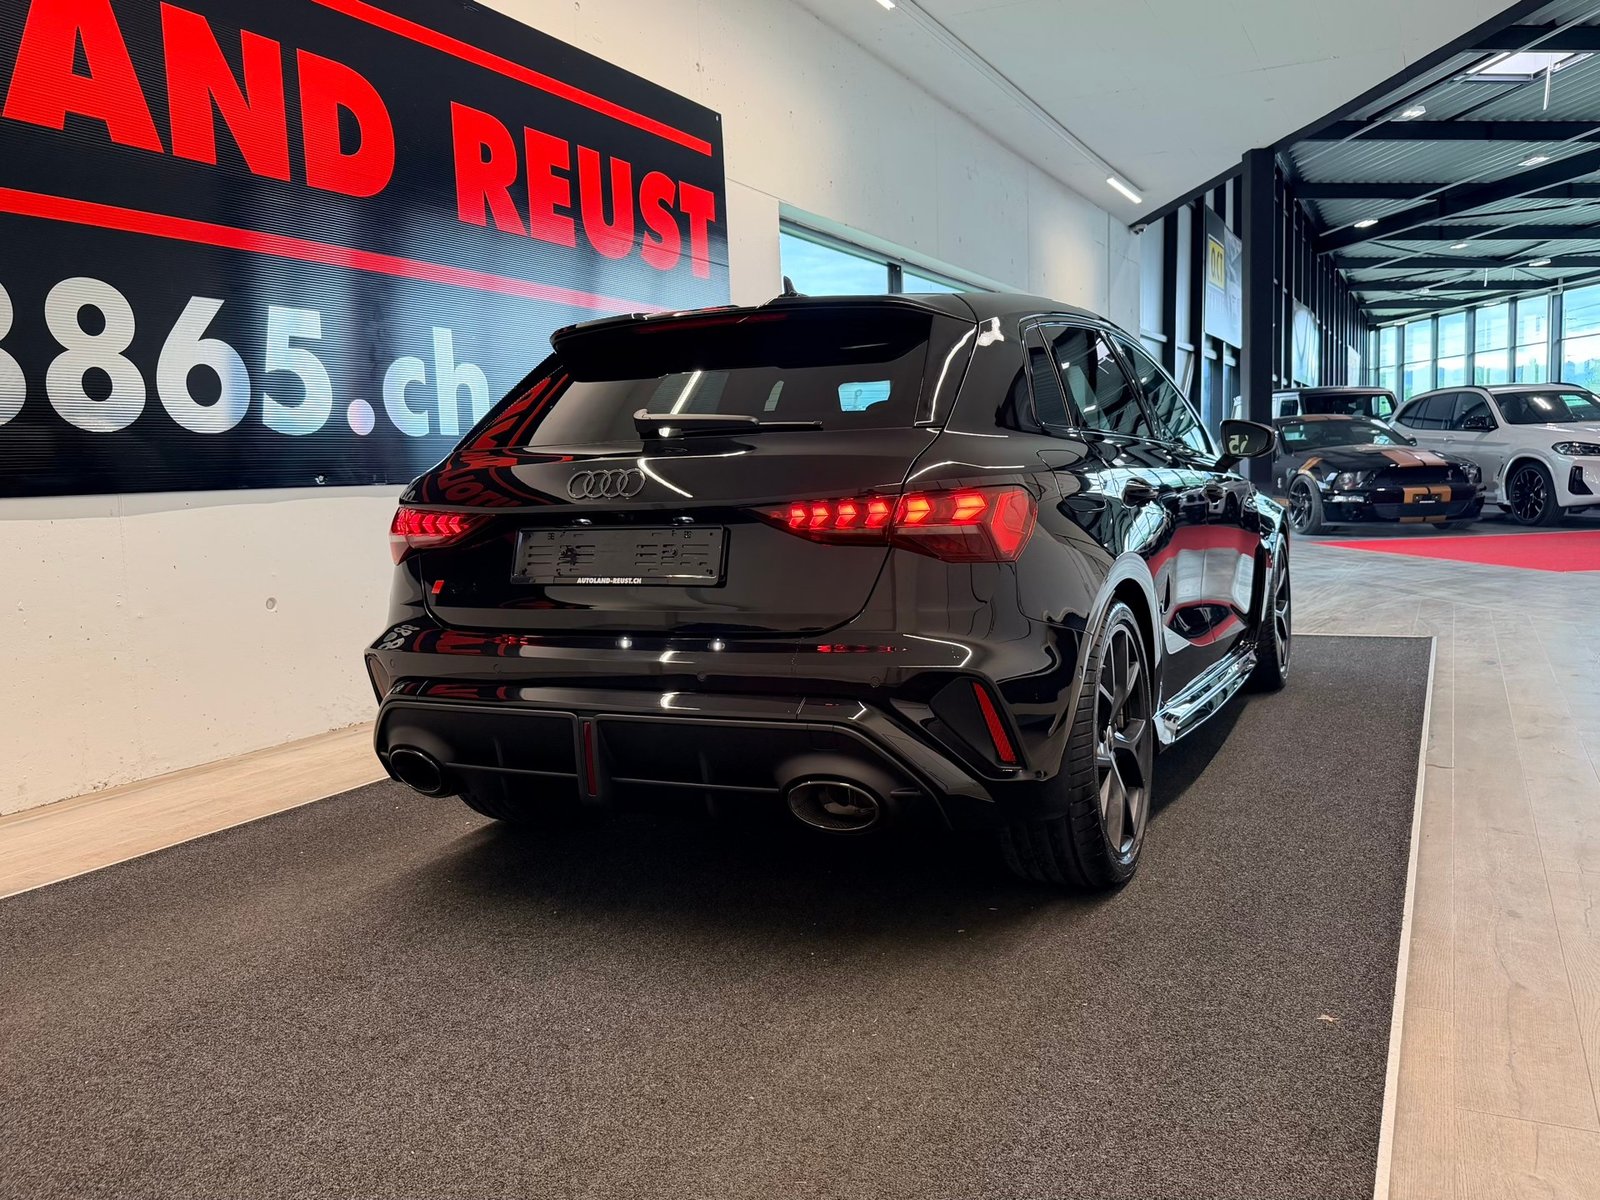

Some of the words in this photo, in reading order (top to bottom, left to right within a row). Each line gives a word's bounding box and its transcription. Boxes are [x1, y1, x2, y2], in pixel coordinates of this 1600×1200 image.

[2, 0, 396, 198] AND
[450, 101, 716, 279] REUST
[0, 276, 491, 437] 865.ch
[576, 577, 642, 585] AUTOLAND-REUST.CH
